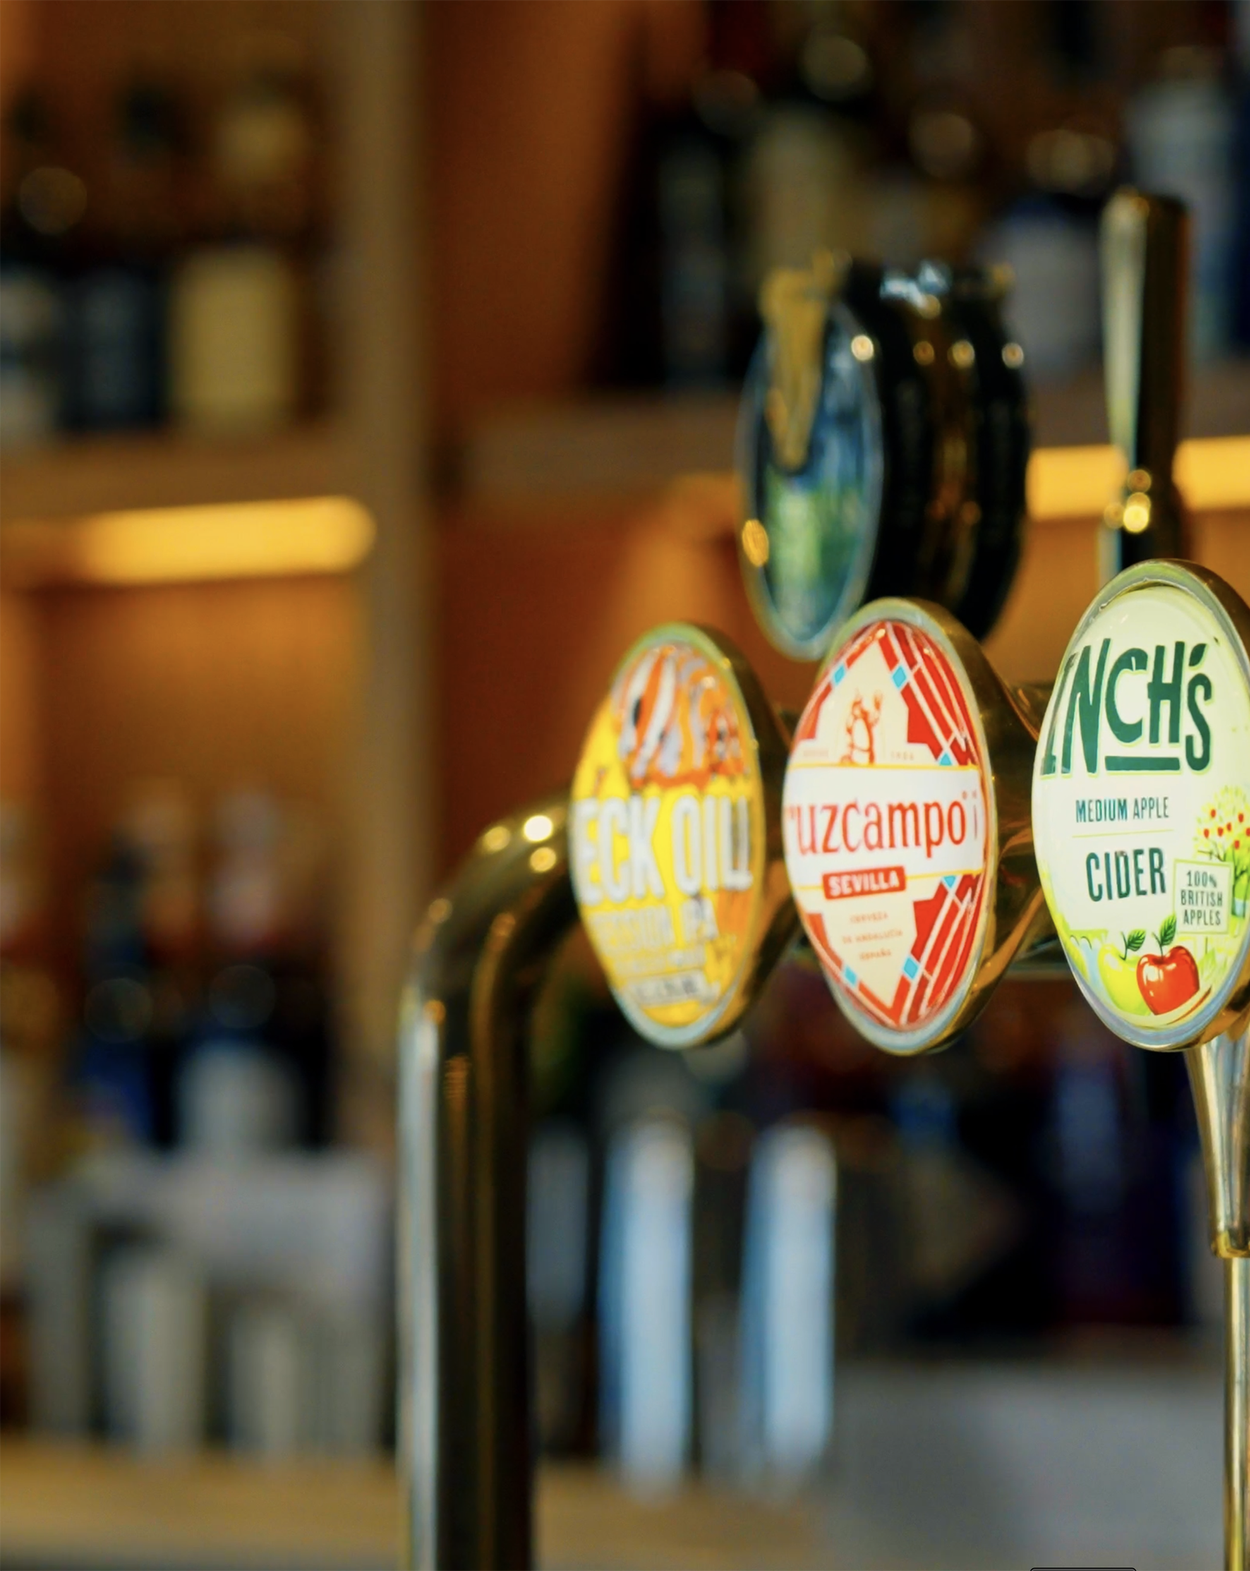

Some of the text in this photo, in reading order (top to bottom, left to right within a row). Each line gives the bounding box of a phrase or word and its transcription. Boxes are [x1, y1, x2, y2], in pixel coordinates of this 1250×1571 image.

[1076, 797, 1169, 823] MEDIUM APPLE
[828, 870, 900, 897] SEVILLA
[1086, 847, 1166, 902] CIDER
[1187, 870, 1217, 888] 100%
[1181, 889, 1223, 907] BRITISH
[1183, 910, 1221, 926] APPLES
